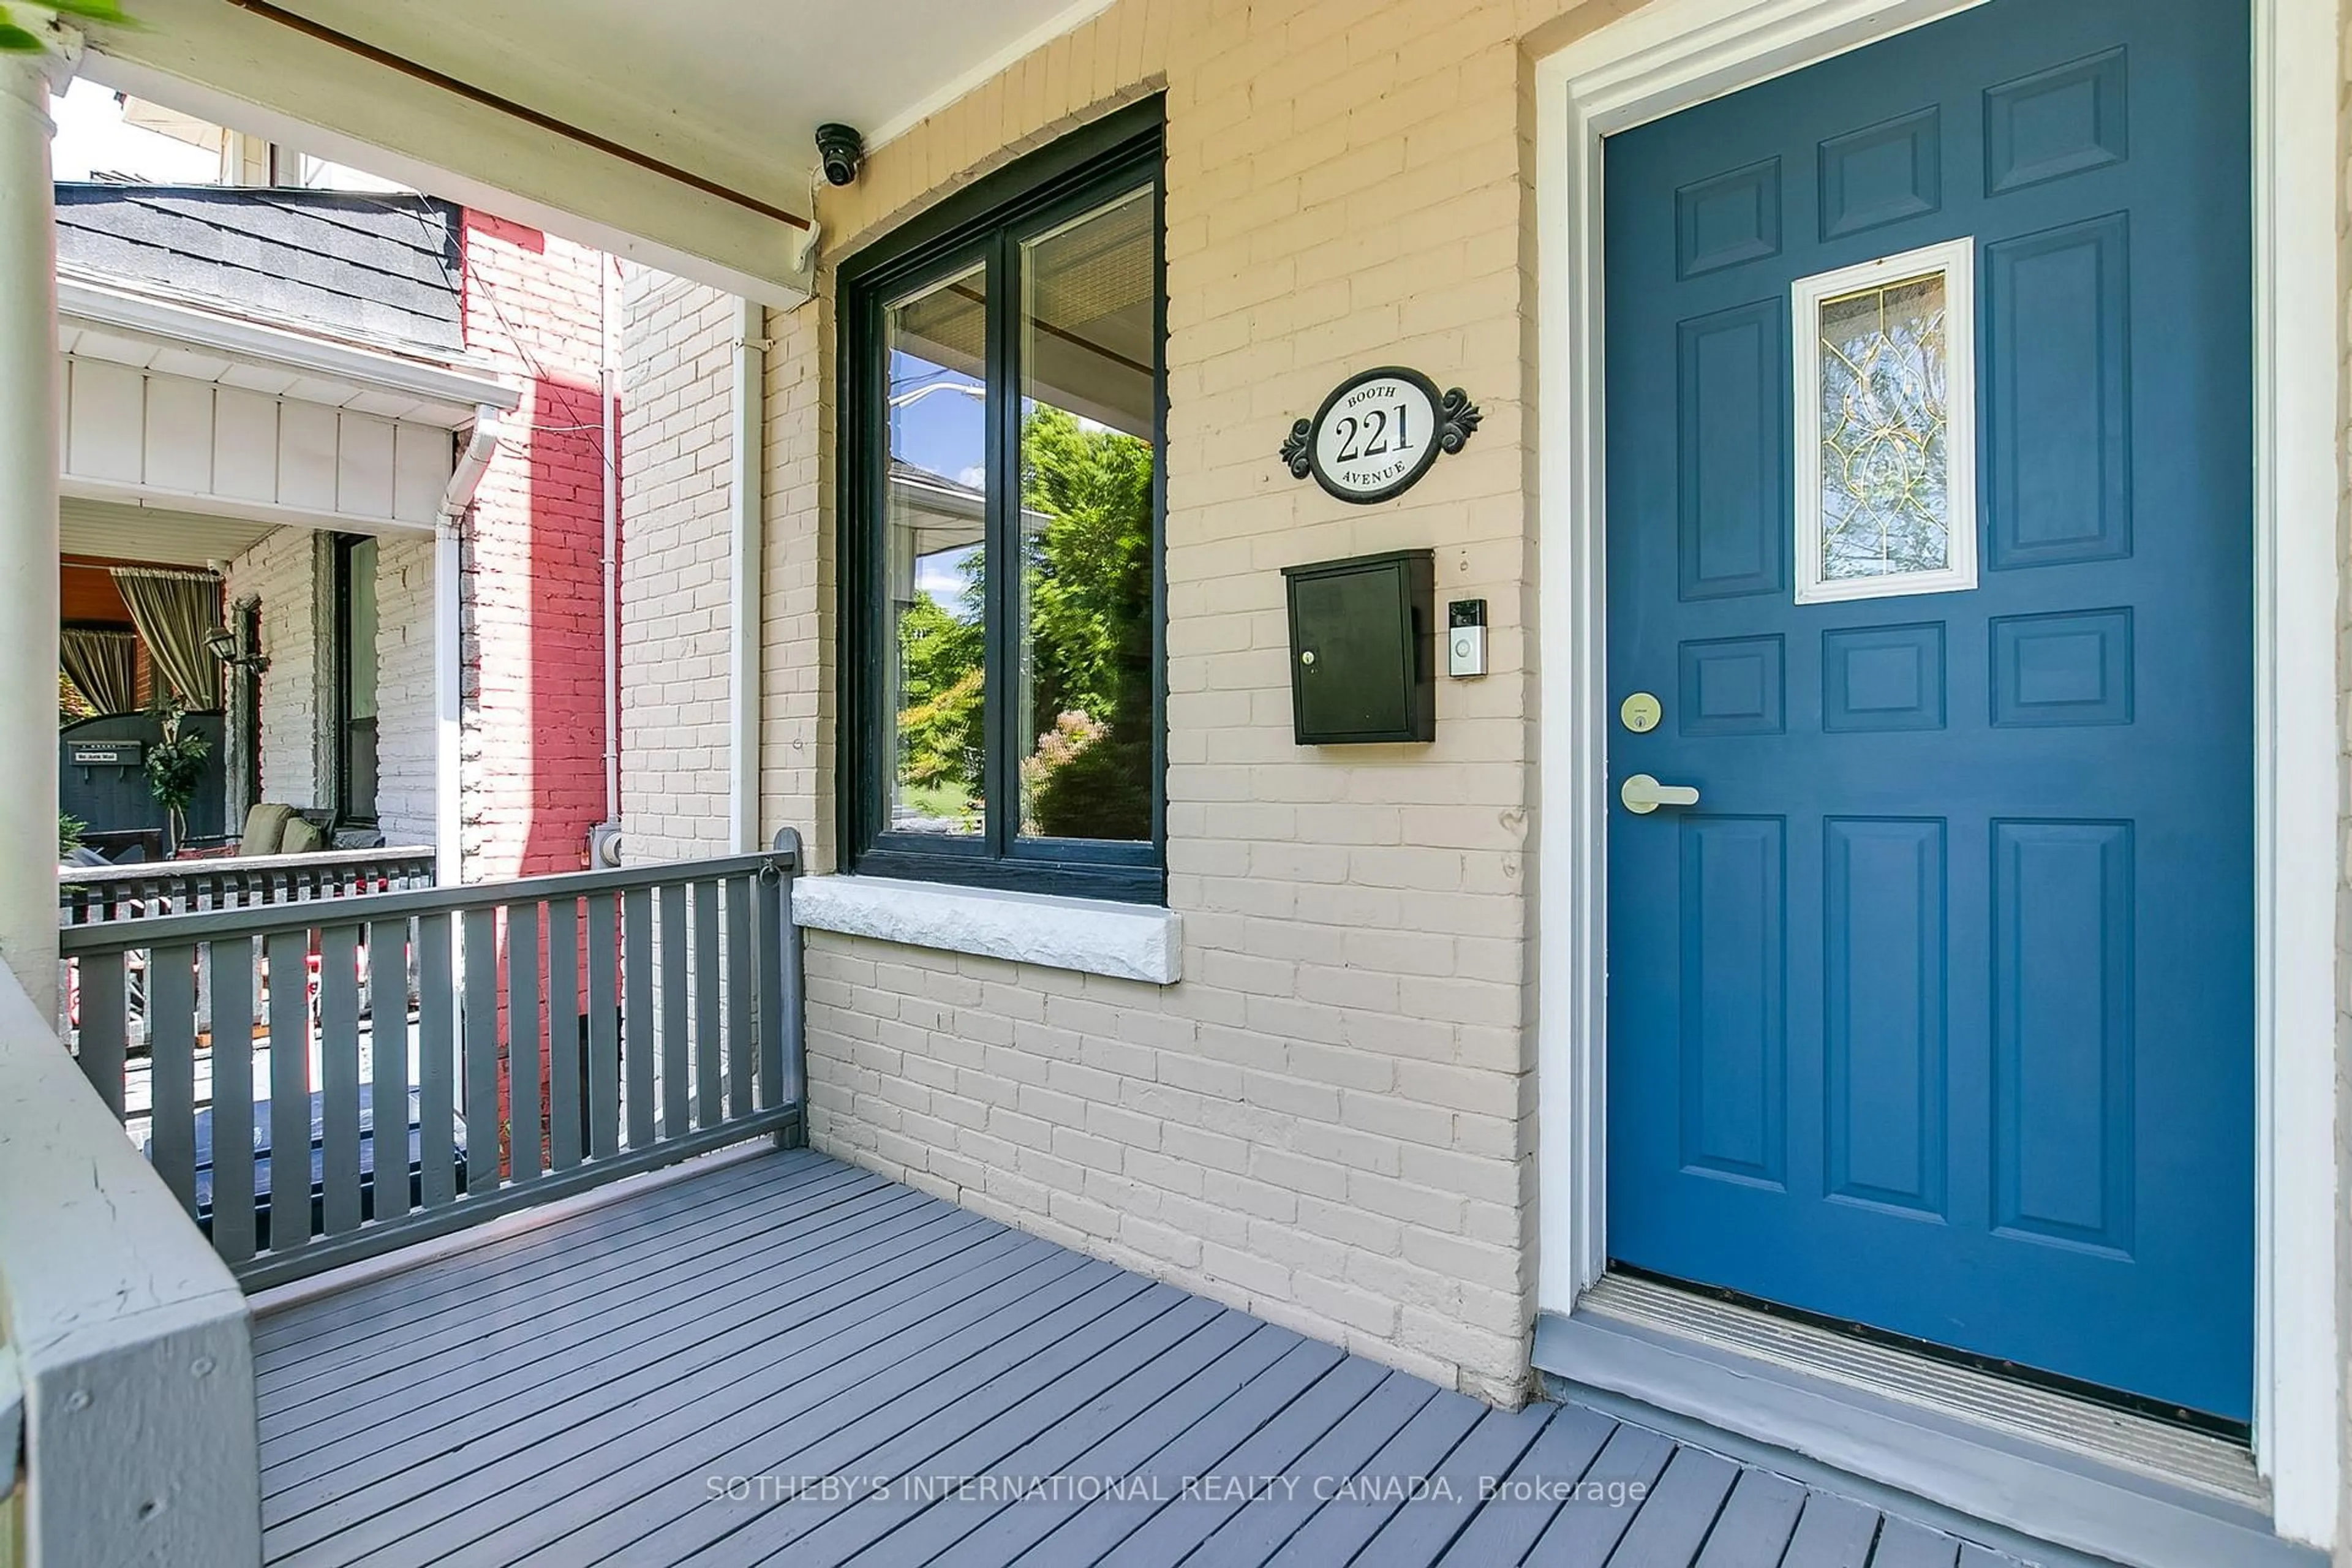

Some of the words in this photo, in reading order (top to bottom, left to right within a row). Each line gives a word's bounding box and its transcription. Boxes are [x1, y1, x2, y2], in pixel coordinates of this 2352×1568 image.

[1348, 386, 1396, 408] BOOTH
[1336, 404, 1413, 463] 221
[1343, 461, 1405, 484] AVENUE
